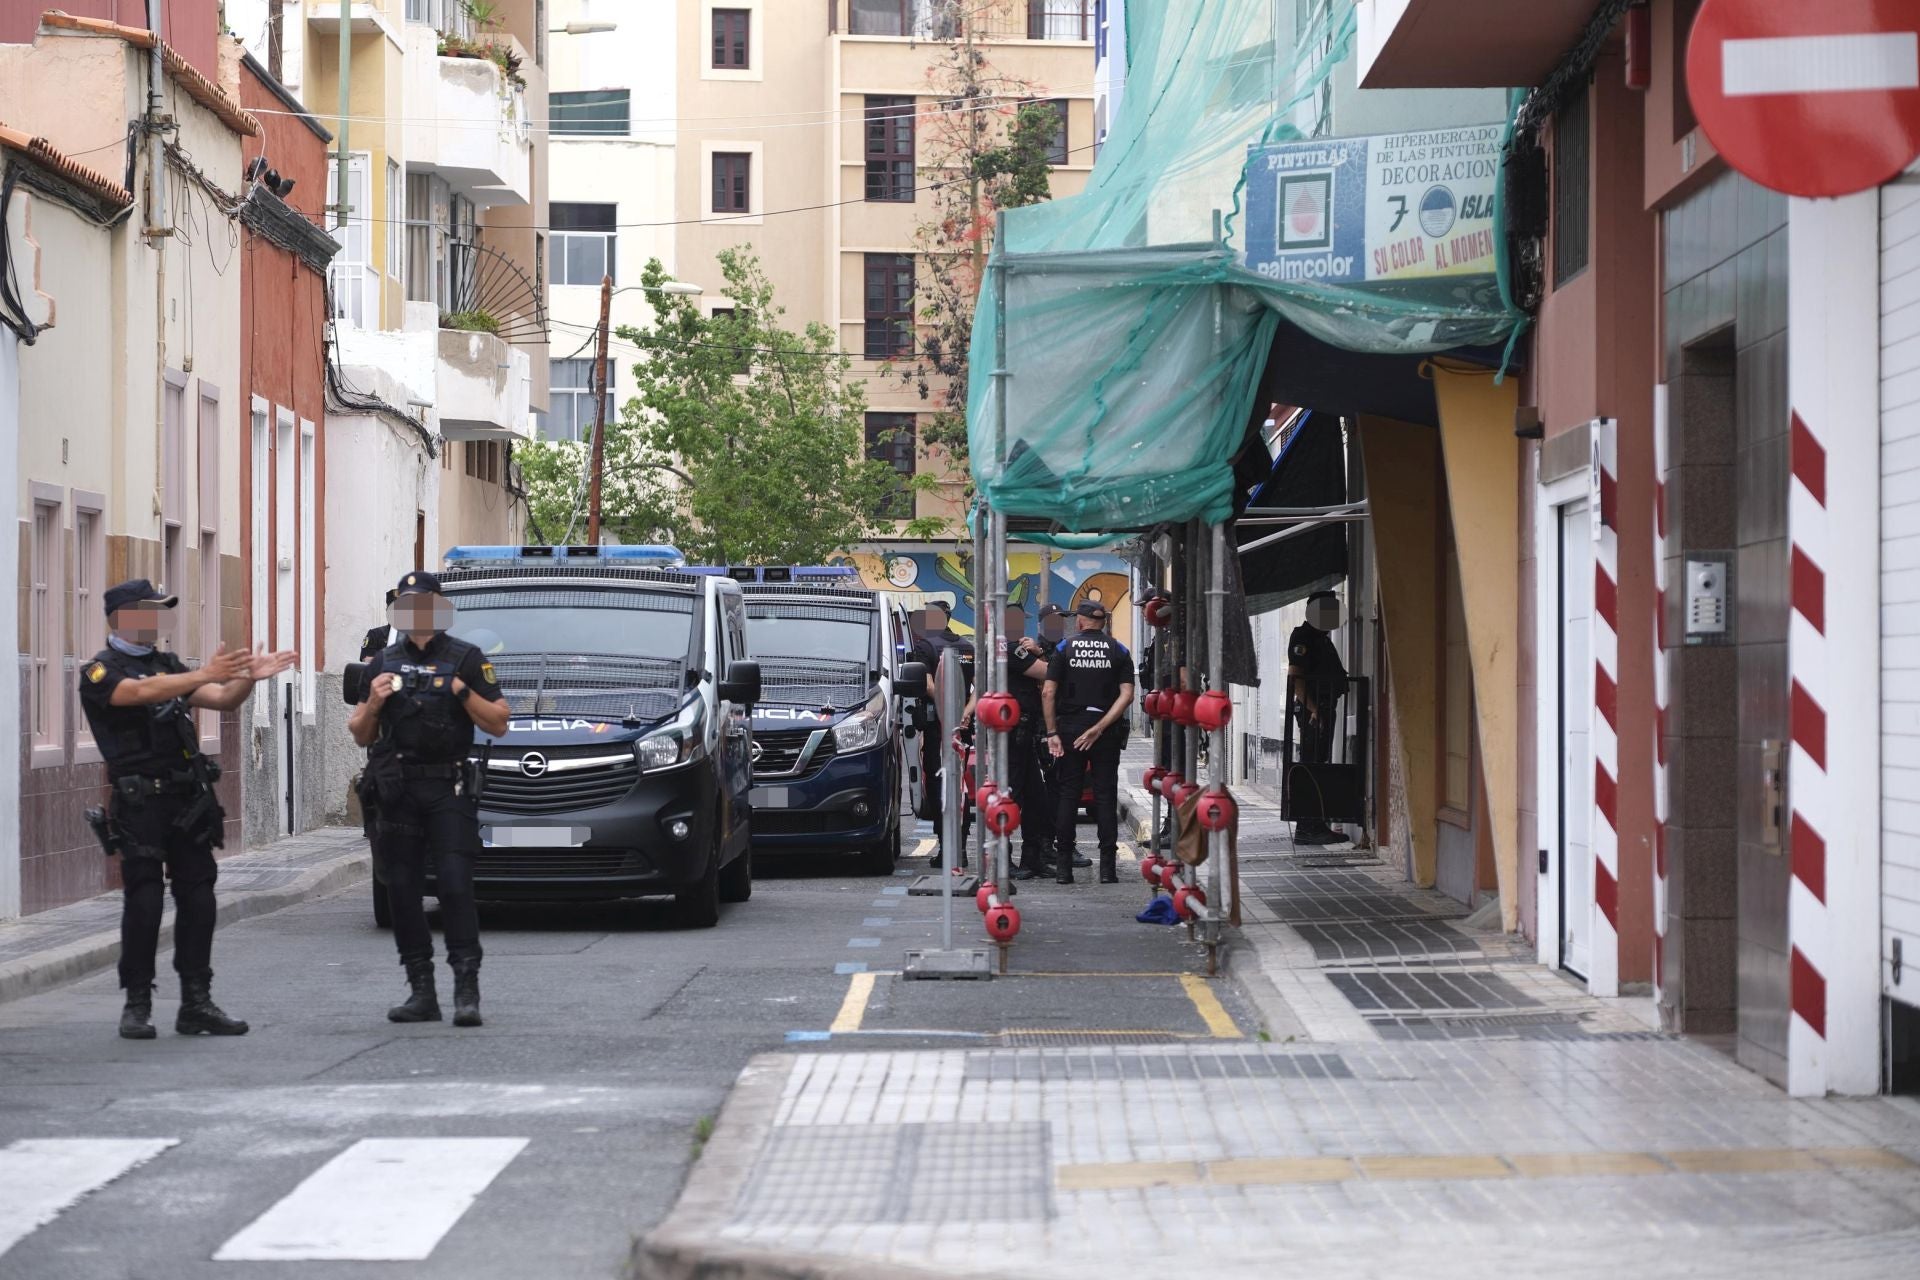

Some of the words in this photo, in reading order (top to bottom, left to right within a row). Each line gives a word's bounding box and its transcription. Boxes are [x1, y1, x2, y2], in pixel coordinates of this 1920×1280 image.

[1384, 127, 1499, 149] HIPERMERCADO
[1267, 148, 1349, 170] PINTURAS
[1376, 151, 1394, 165] DE
[1399, 147, 1426, 162] LAS
[1431, 141, 1504, 160] PINTURAS
[1381, 159, 1498, 186] DECORACION
[1387, 194, 1410, 233] 7
[1460, 194, 1496, 220] ISLA
[1374, 246, 1389, 275] SU
[1390, 236, 1426, 270] COLOR
[1435, 242, 1449, 271] AL
[1450, 228, 1494, 265] MOMEN
[1257, 253, 1354, 280] palmcolor
[1071, 640, 1110, 649] POLICIA
[1075, 649, 1107, 658] LOCAL
[1069, 658, 1112, 669] CANARIA
[752, 708, 820, 720] ICIA
[507, 719, 595, 732] LICIA
